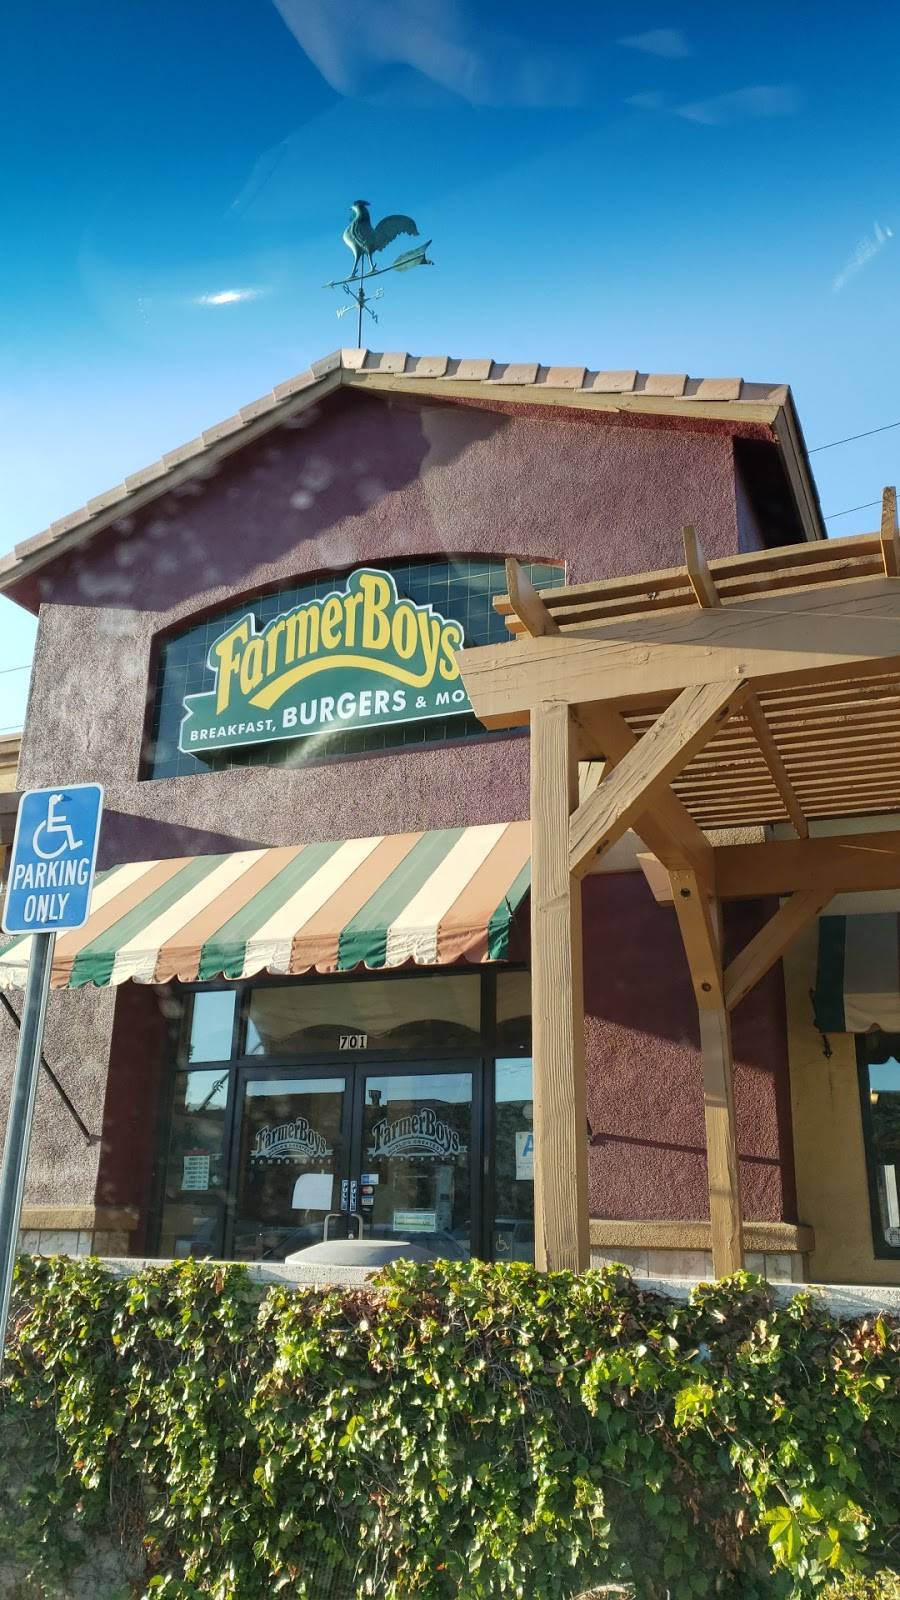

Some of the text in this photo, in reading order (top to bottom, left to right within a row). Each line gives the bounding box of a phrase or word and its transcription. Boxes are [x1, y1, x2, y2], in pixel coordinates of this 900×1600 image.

[190, 719, 277, 742] BREAKFAST,
[282, 689, 407, 729] BURGERS
[415, 696, 427, 708] &
[13, 857, 90, 890] PARKING
[23, 893, 70, 923] ONLY
[340, 1035, 366, 1049] 701
